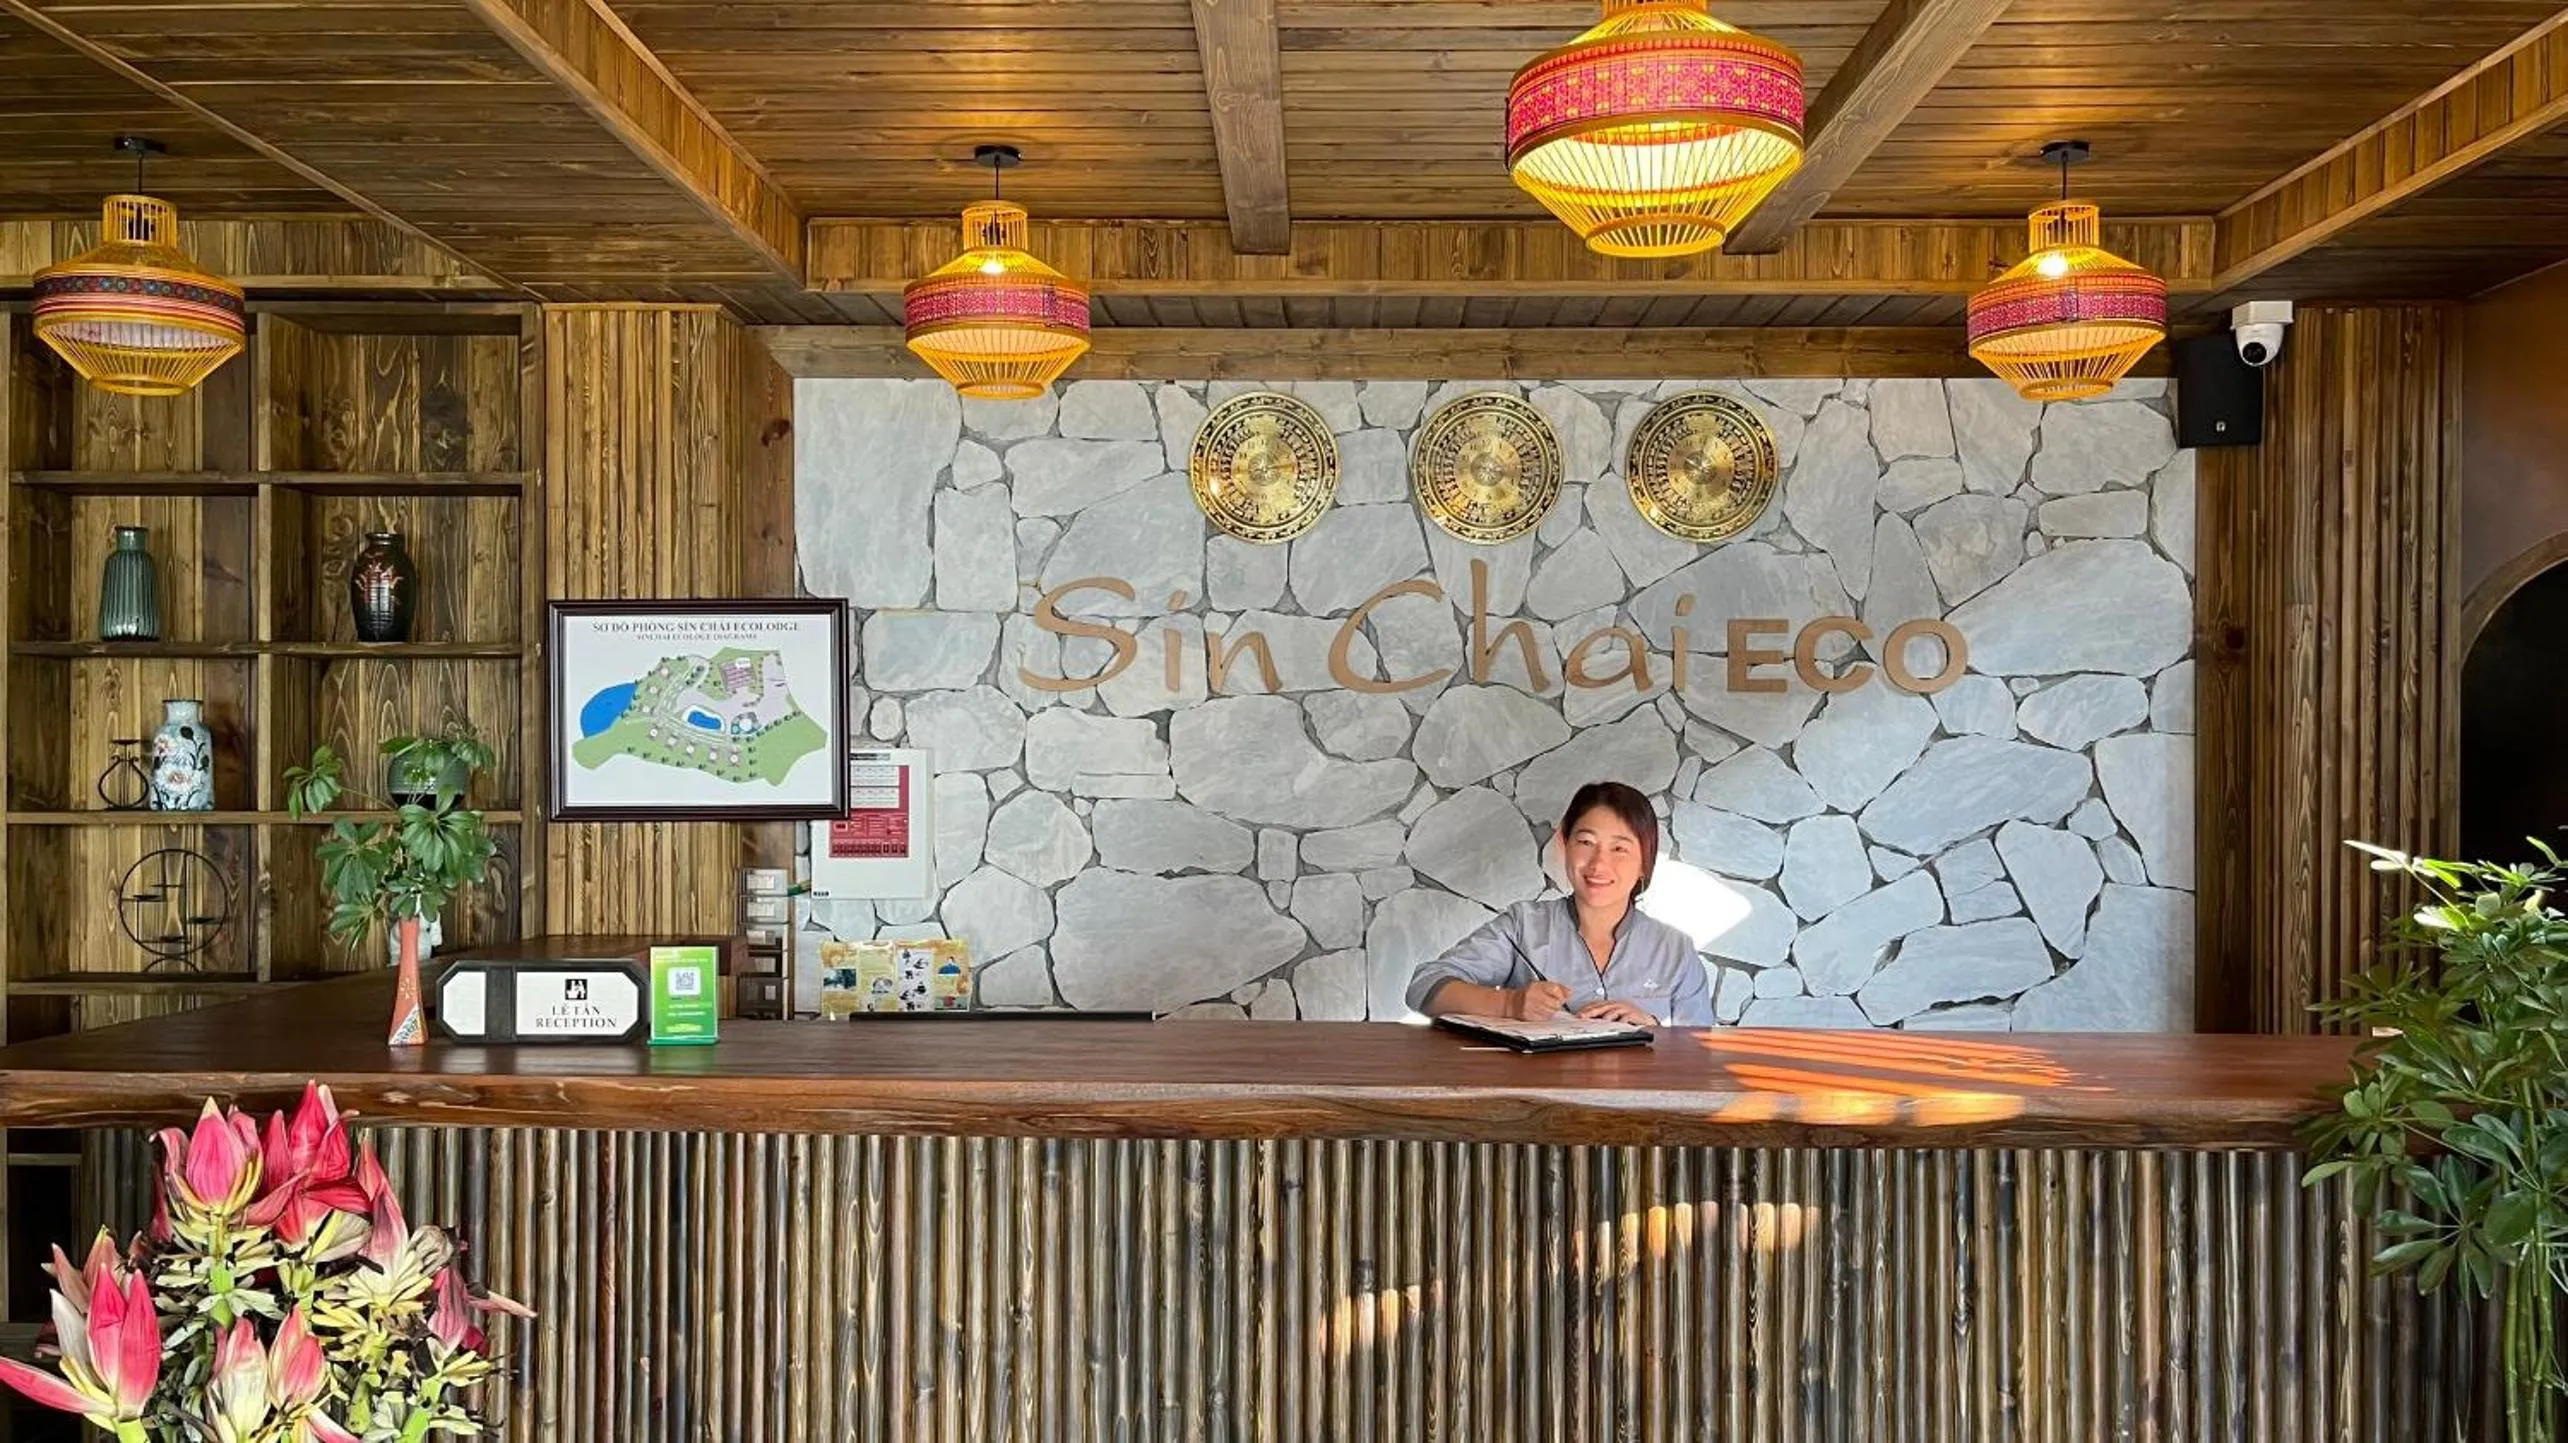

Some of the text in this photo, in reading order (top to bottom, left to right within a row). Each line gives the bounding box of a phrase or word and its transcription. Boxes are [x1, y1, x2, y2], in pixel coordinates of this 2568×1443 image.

[1018, 558, 1968, 696] Sin Chai ECO
[536, 1017, 617, 1028] RECEPTION
